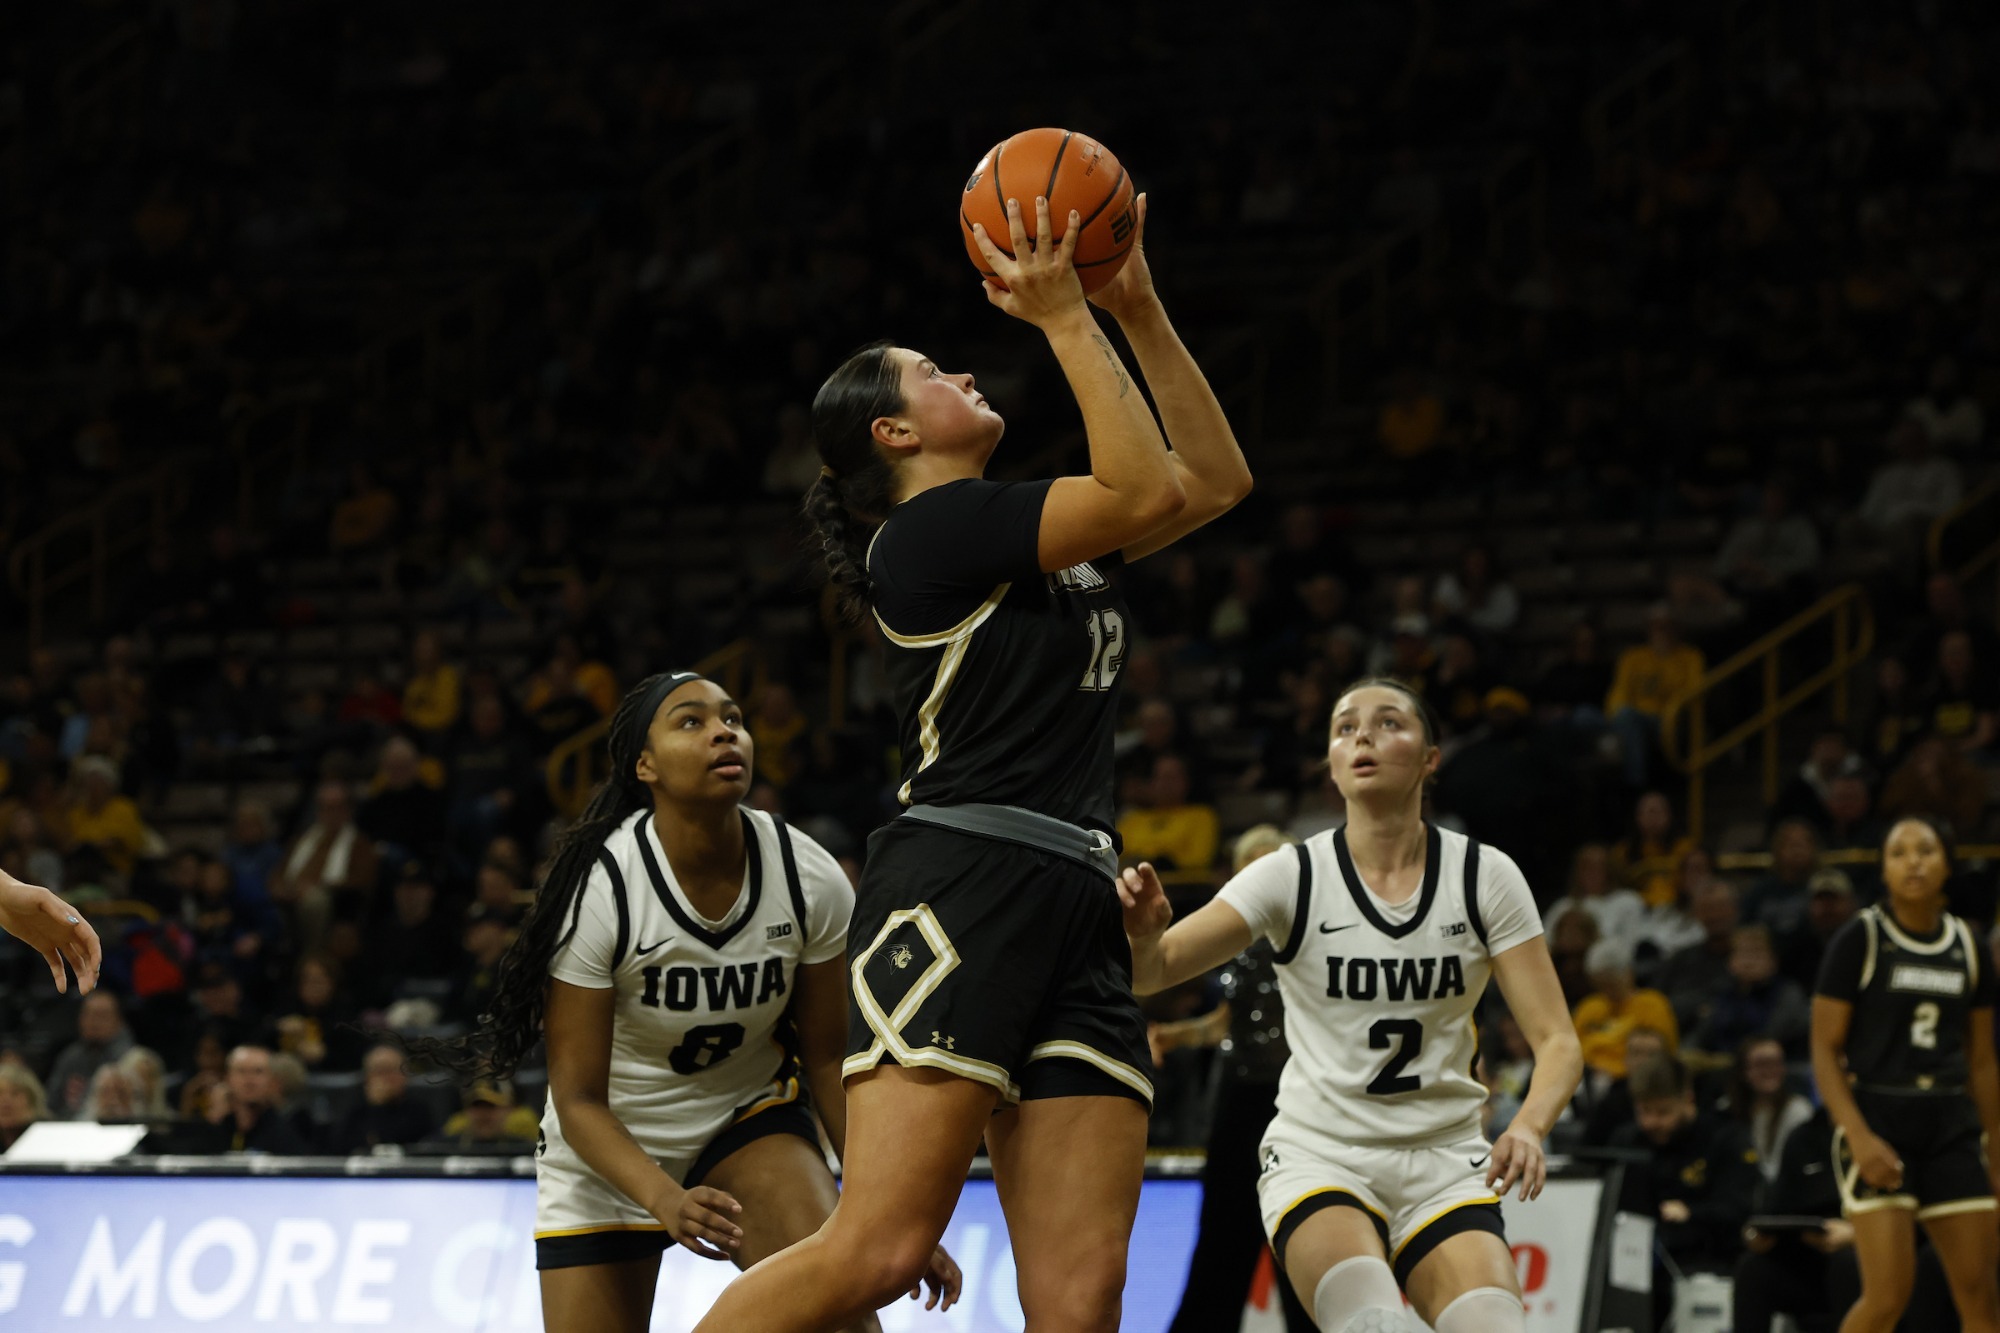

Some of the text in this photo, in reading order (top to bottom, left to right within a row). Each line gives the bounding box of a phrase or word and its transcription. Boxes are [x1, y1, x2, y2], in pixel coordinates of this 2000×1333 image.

[1079, 608, 1125, 691] 12
[641, 957, 786, 1012] IOWA
[1326, 955, 1466, 1002] IOWA
[1366, 1018, 1423, 1095] 2
[1911, 1002, 1940, 1048] 2
[62, 1213, 412, 1324] MORE
